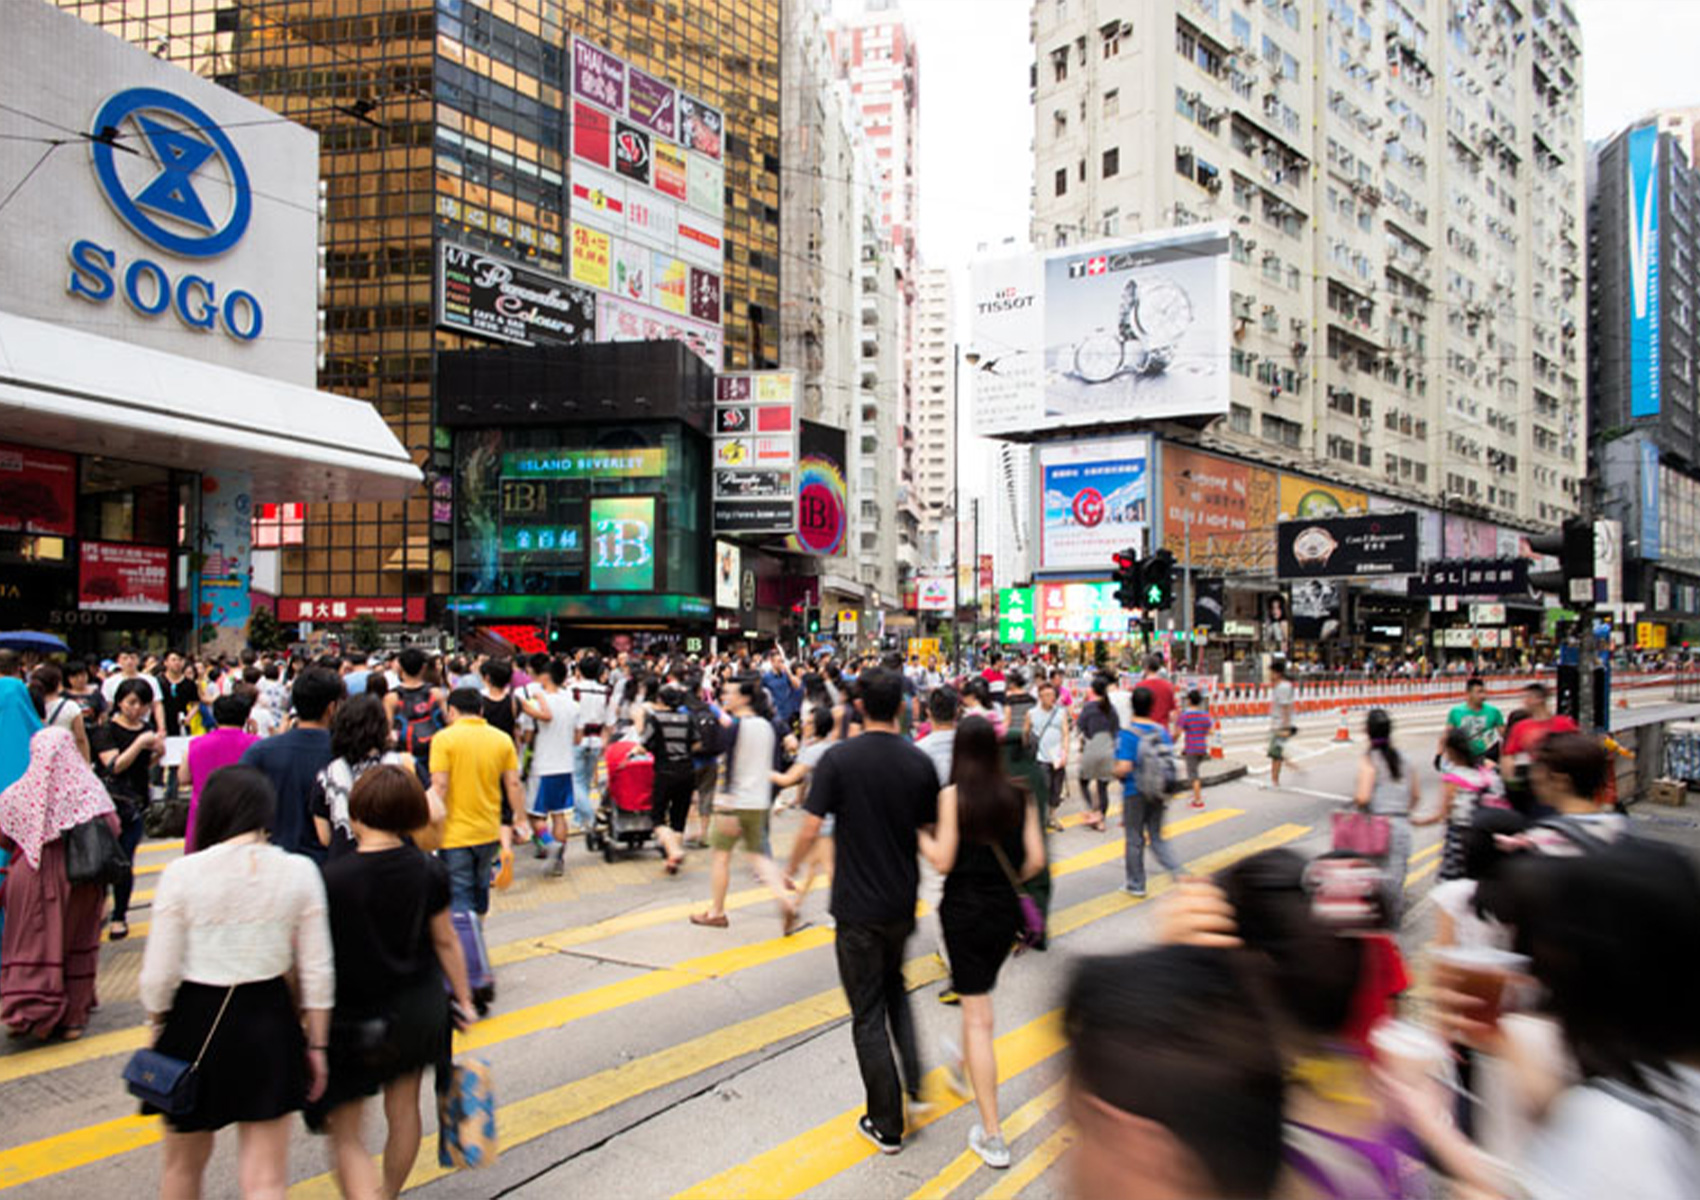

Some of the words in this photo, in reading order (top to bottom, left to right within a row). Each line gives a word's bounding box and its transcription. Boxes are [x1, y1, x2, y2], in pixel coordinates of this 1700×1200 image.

[67, 240, 263, 342] SOGO
[977, 295, 1036, 314] TISSOT
[517, 458, 572, 471] ISLAND
[577, 457, 644, 470] BEVERLEY
[503, 483, 535, 512] iB
[801, 494, 825, 530] iB
[595, 519, 652, 567] iB
[49, 610, 108, 625] SOGO
[298, 601, 347, 618] 周大福
